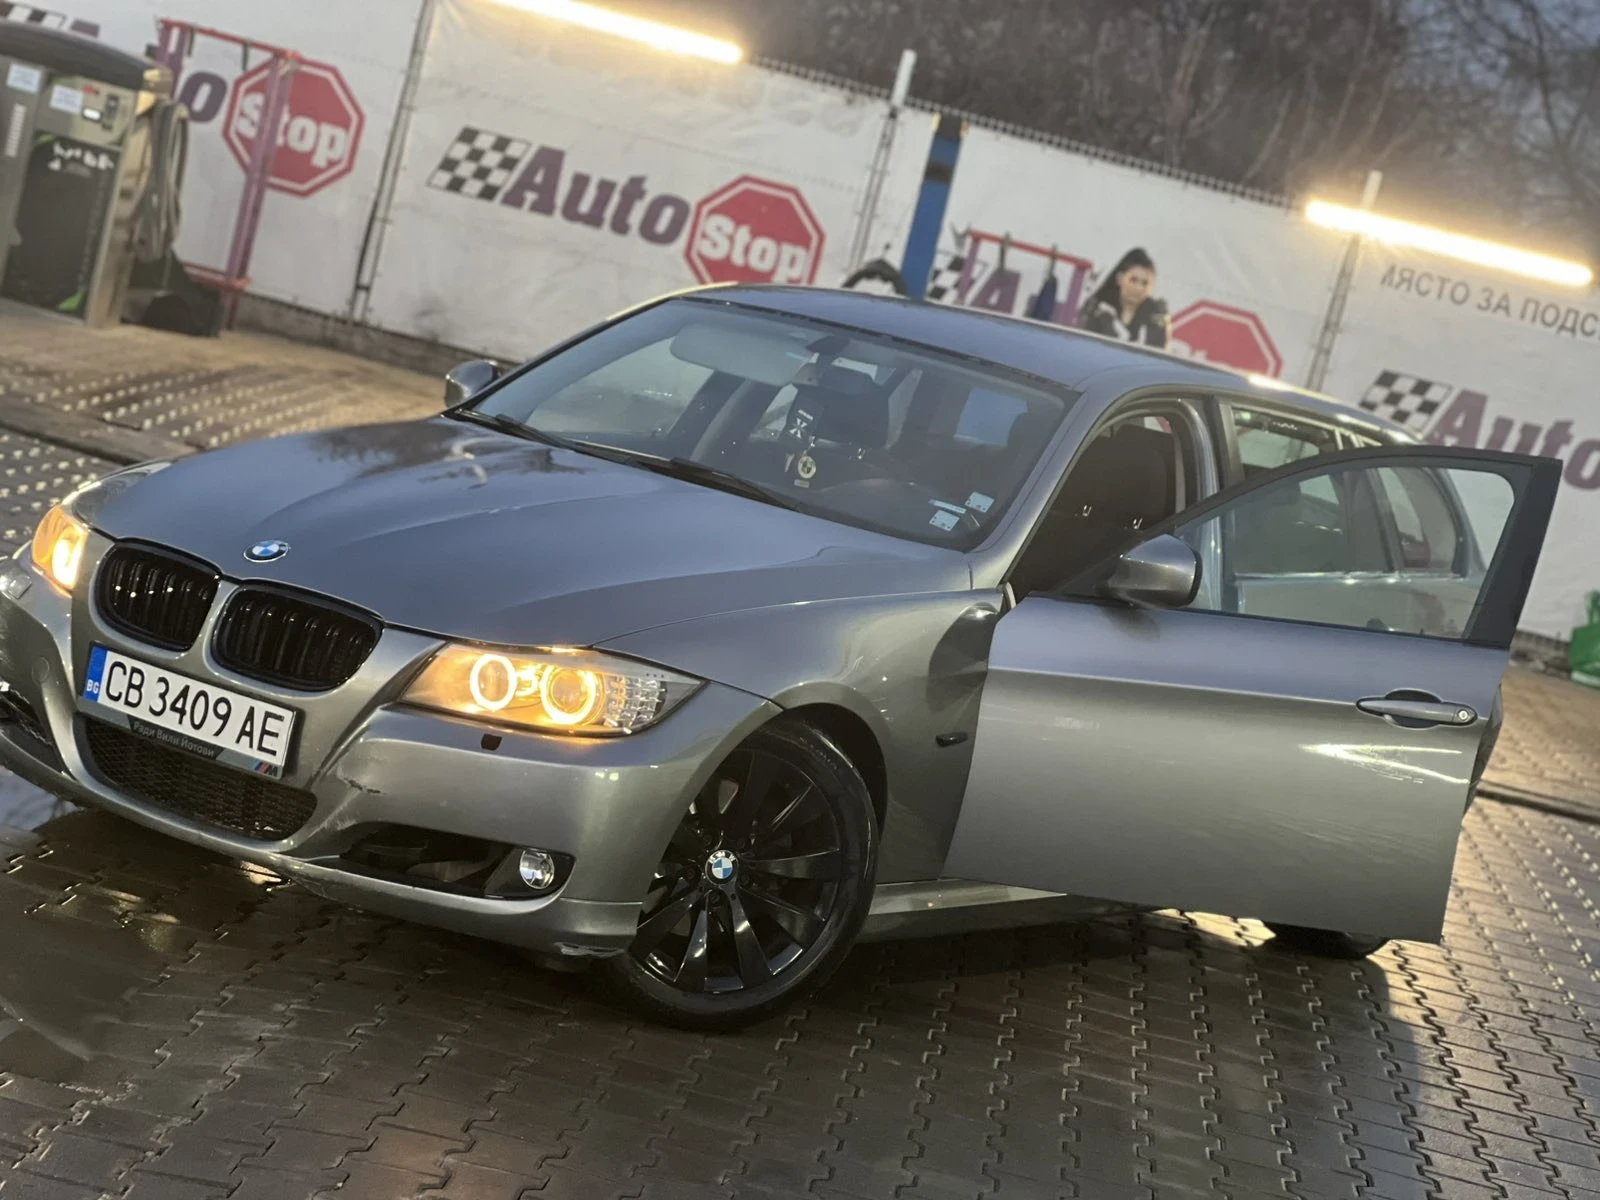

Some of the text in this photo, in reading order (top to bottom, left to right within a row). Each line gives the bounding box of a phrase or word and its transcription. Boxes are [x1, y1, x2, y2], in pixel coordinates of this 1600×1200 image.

[501, 145, 691, 245] Auto
[701, 214, 809, 282] Stop
[1476, 286, 1512, 317] ЗА
[86, 679, 100, 693] BG
[148, 676, 232, 737] 3409
